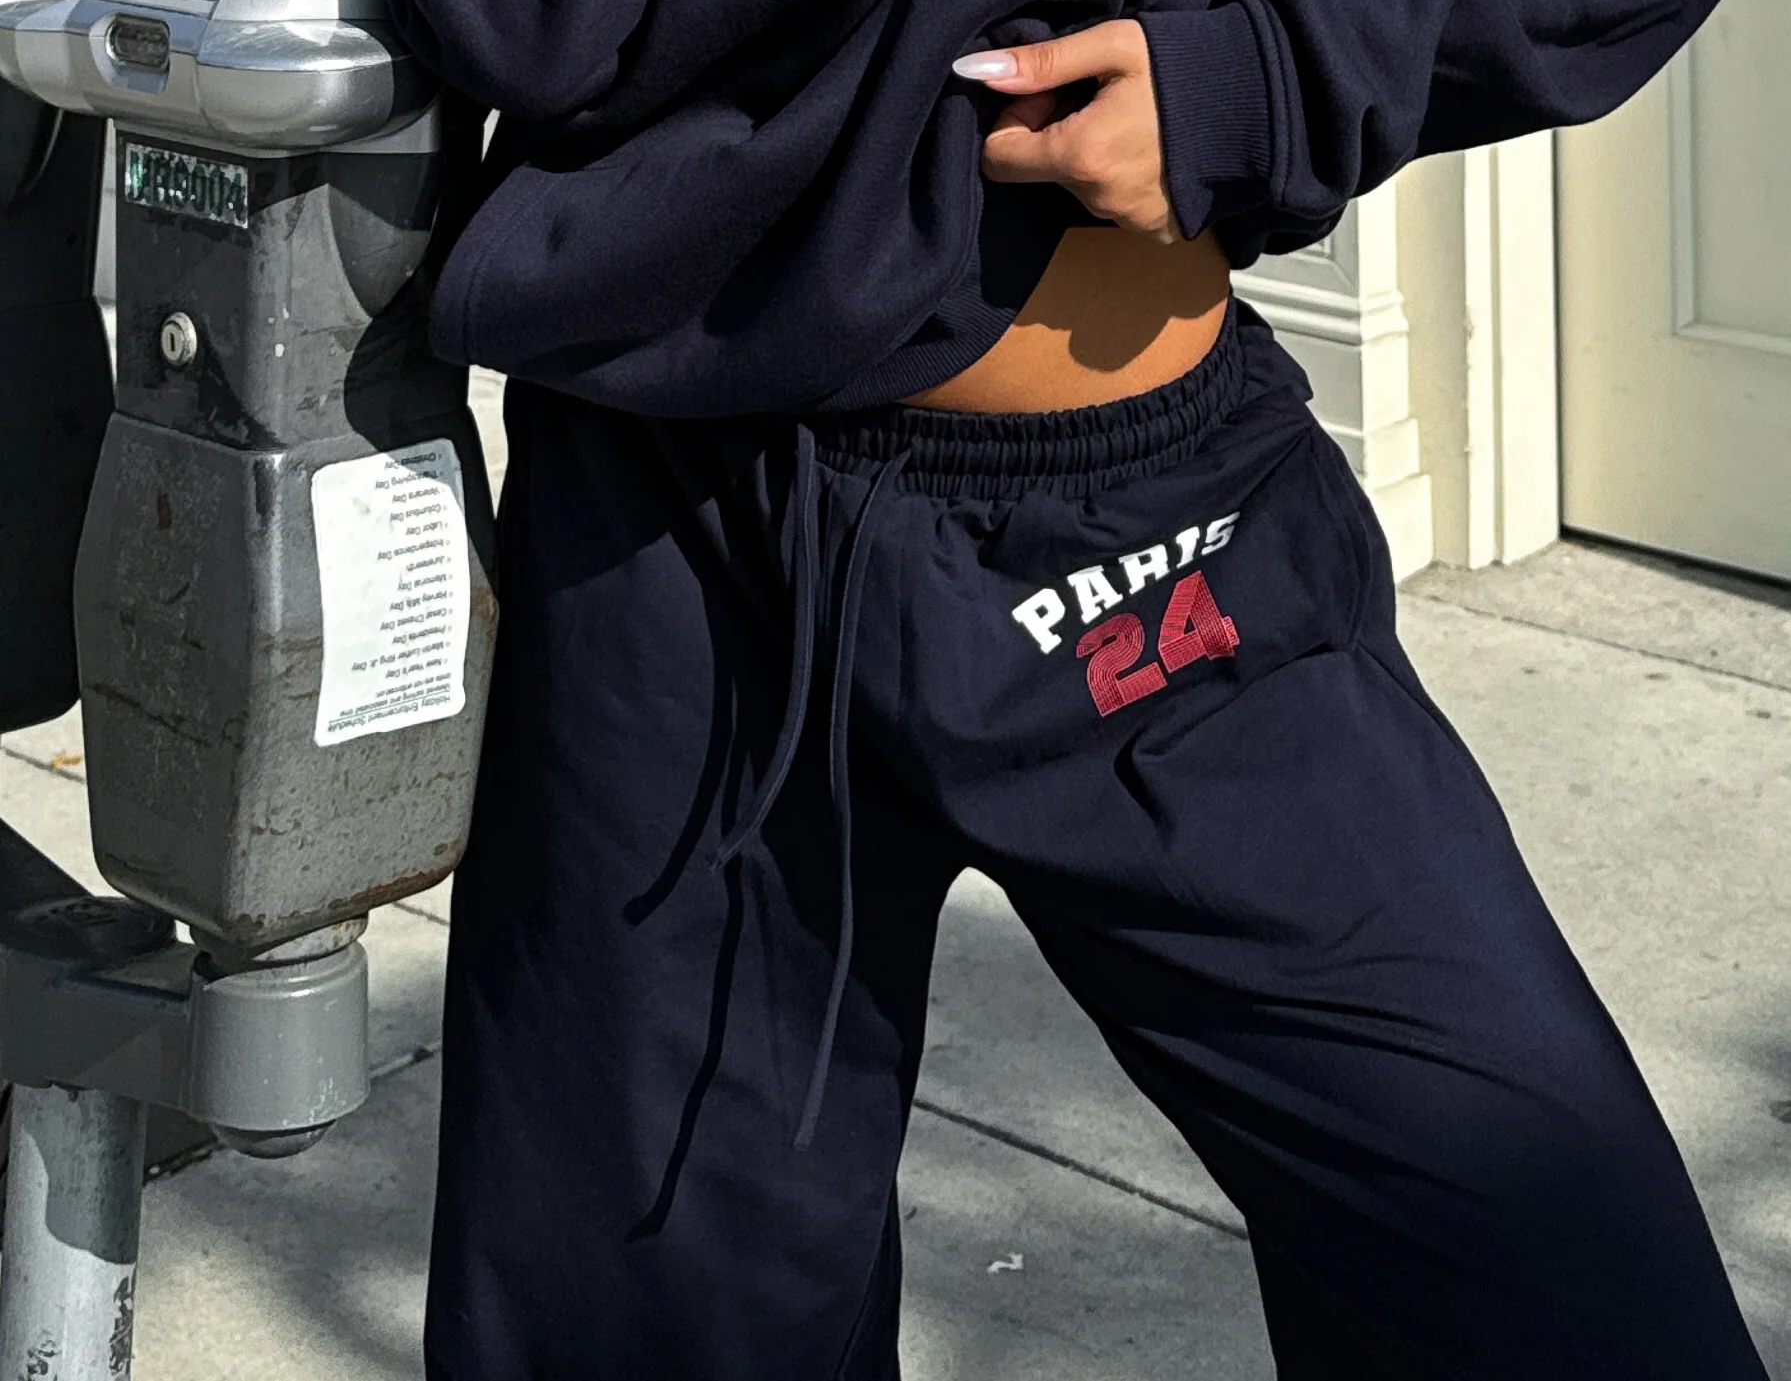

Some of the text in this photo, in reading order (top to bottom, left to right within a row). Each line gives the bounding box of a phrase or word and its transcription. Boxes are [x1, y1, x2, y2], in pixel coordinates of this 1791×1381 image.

[385, 453, 436, 470] Christmas Day
[375, 470, 437, 490] Thanksgiving Day
[392, 488, 438, 504] Veterans Day
[390, 504, 441, 522] Columbus Day
[405, 521, 442, 536] Labor Day
[377, 540, 443, 561] Independence Day
[406, 556, 445, 572] Juneteenth
[397, 574, 447, 591] Memorial Day
[1011, 511, 1240, 654] PARIS
[390, 591, 447, 611] Harvey Milk Day
[380, 608, 447, 631] Cesar Chavez Day
[392, 635, 407, 645] Day
[1076, 570, 1240, 717] 24
[351, 642, 444, 672] Martin Luther King Jr. Day
[385, 658, 442, 679] New Year's Day
[328, 696, 451, 732] Holiday Enforcement Schedule
